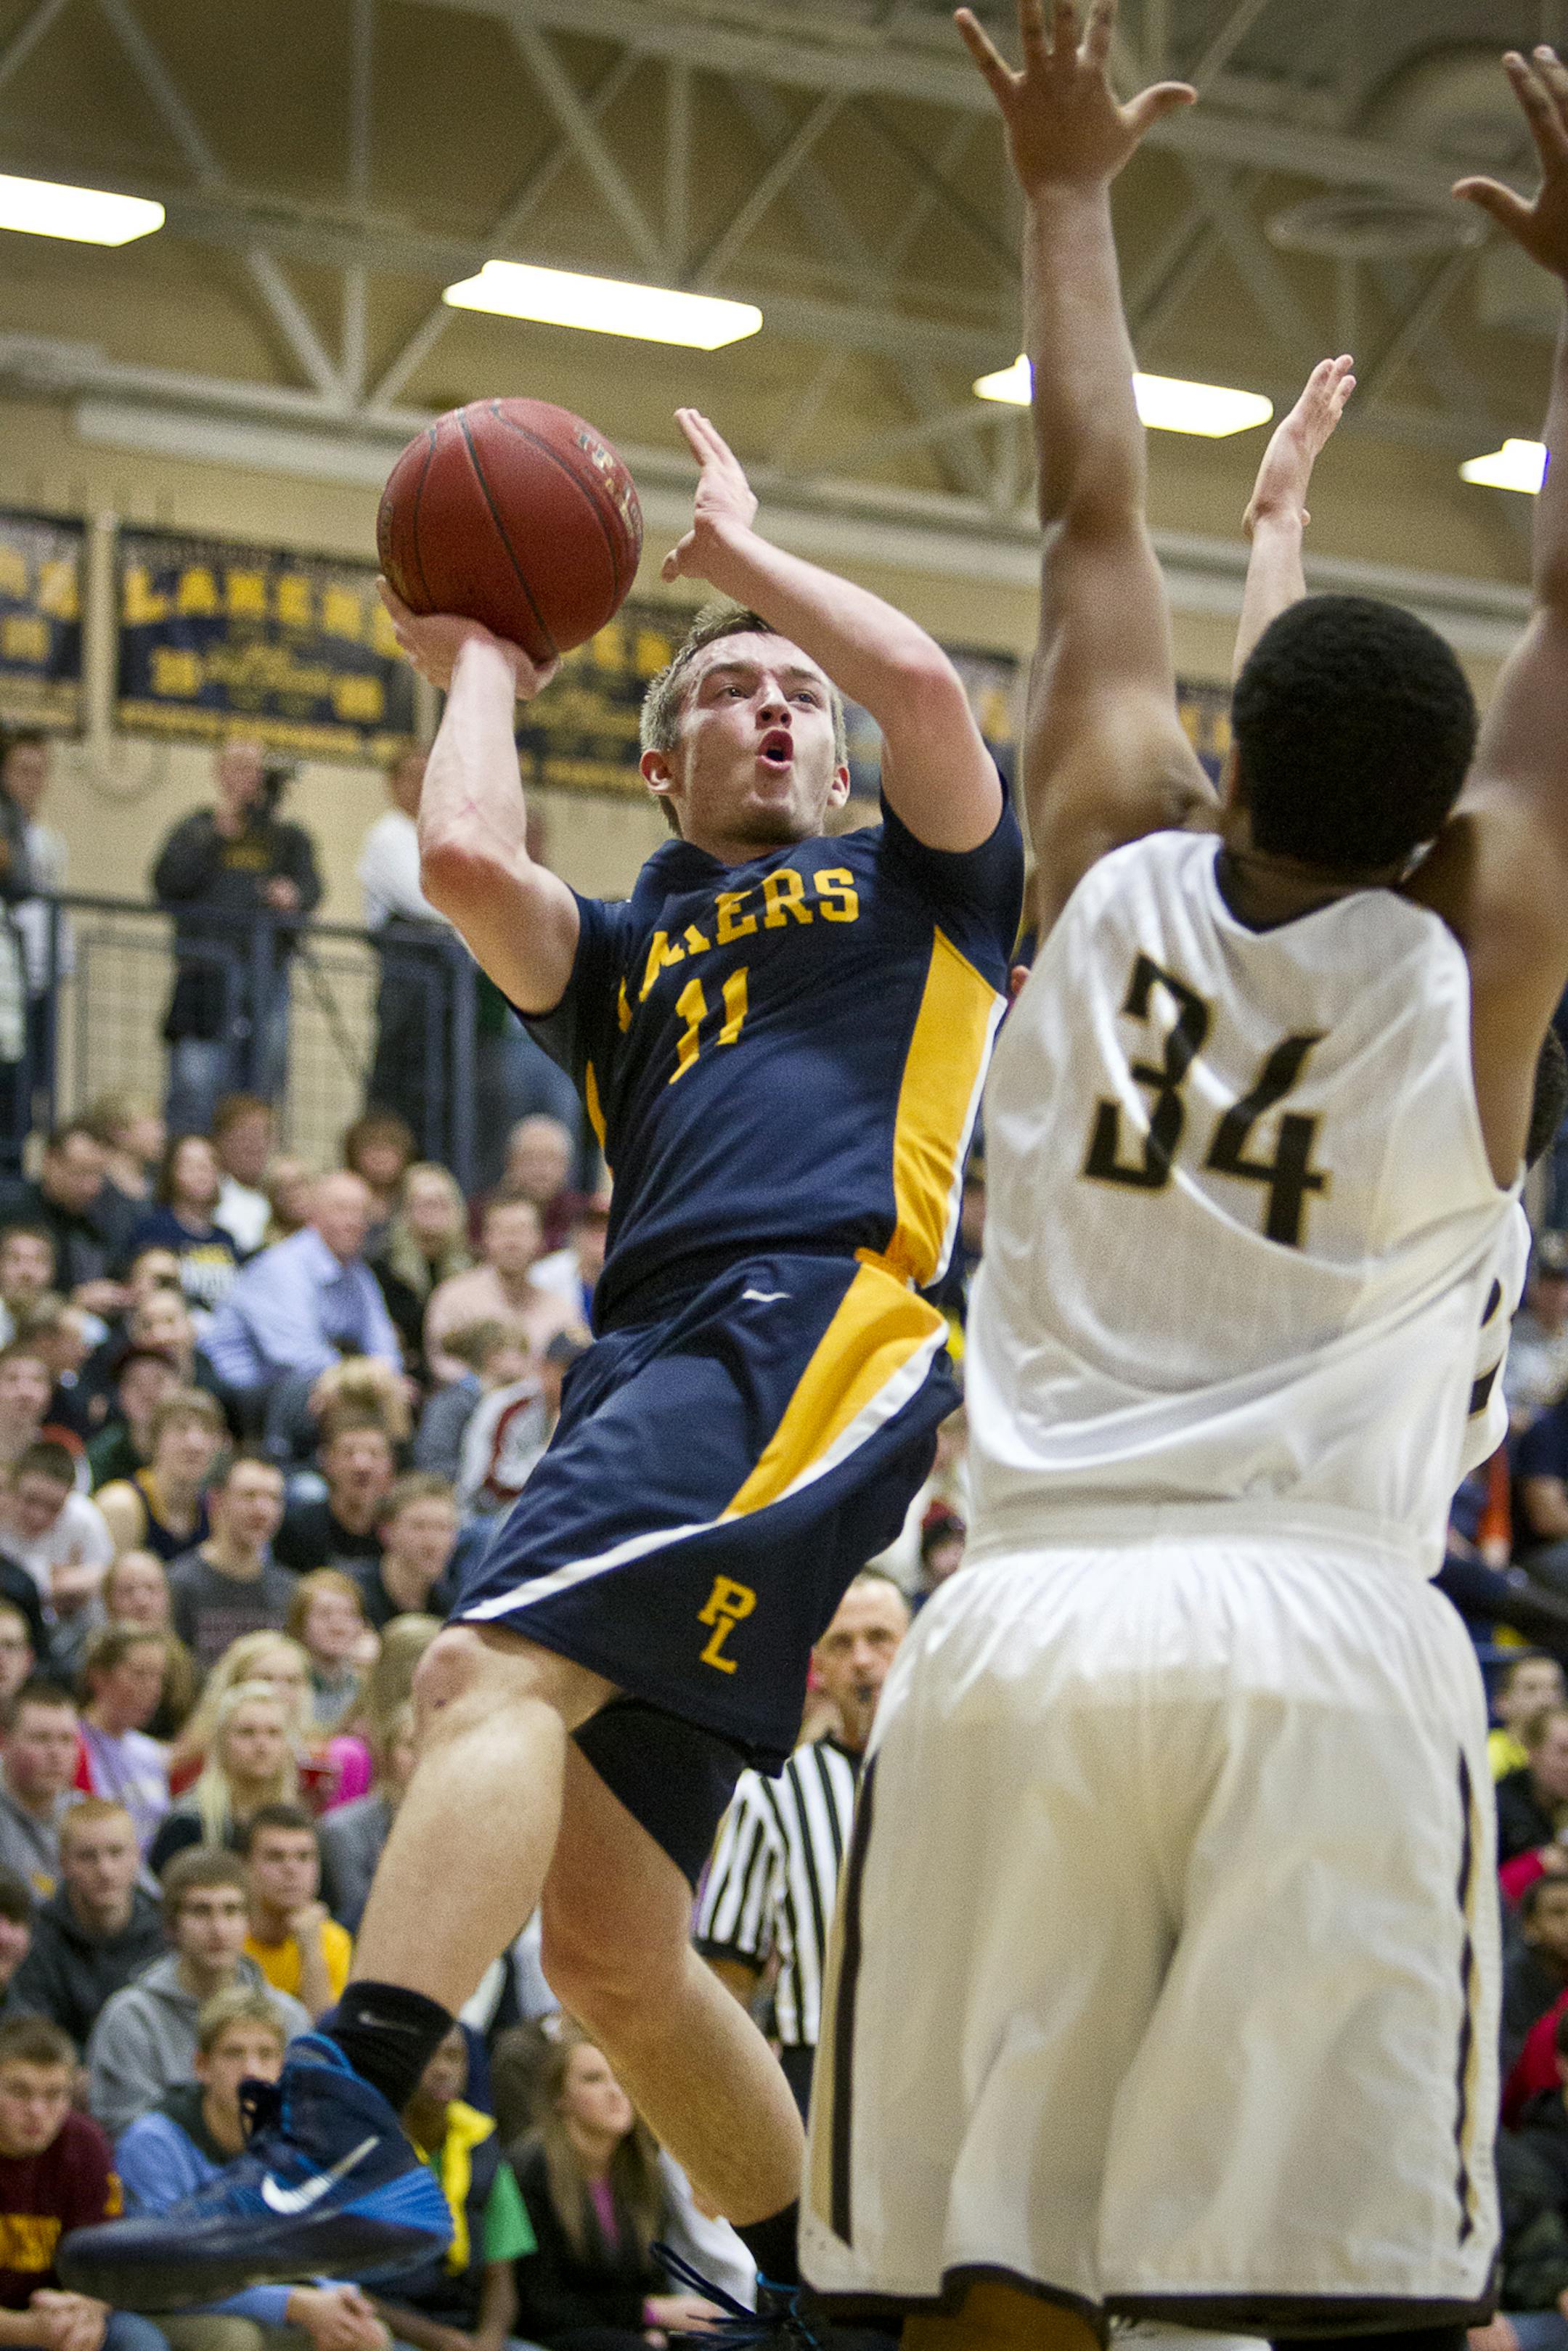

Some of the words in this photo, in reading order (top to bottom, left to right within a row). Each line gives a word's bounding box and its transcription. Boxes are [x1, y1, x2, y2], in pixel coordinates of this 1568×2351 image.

[618, 868, 859, 1032] ERS
[669, 967, 749, 1084] 11
[1081, 948, 1333, 1252] 34
